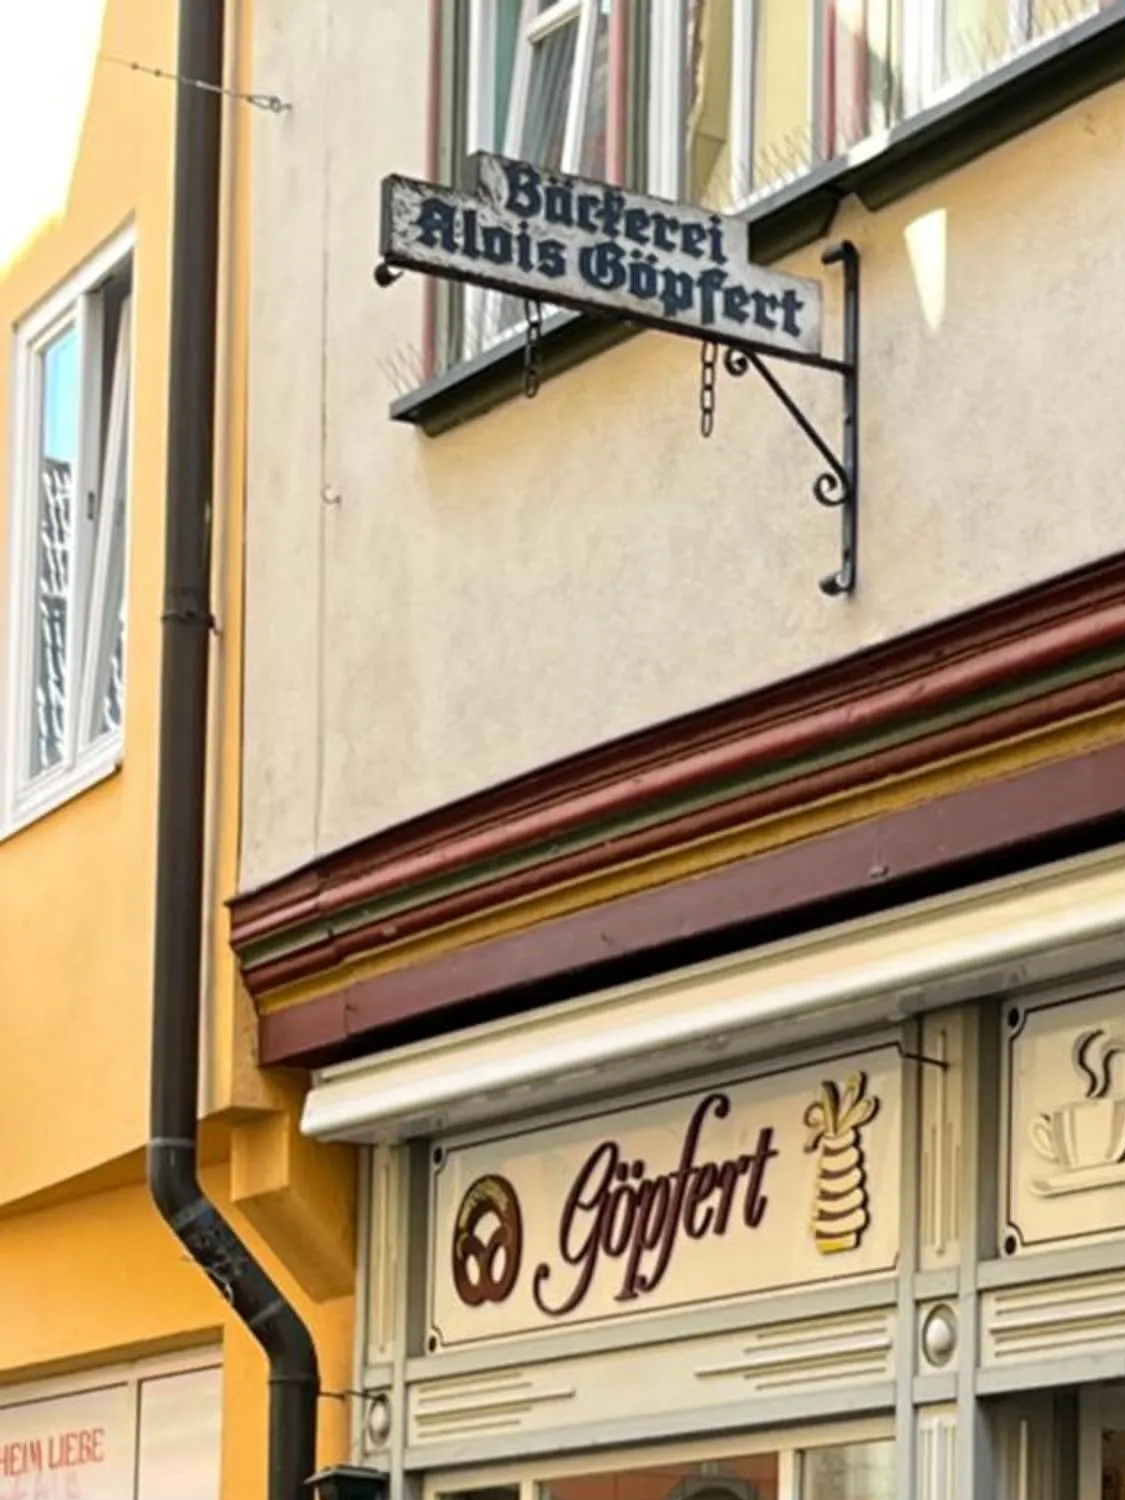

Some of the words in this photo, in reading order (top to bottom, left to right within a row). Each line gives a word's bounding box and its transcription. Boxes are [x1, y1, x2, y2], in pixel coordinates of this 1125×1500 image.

[415, 198, 567, 278] Alois
[578, 242, 805, 338] Göpfert
[503, 162, 728, 265] Bäckerei
[532, 1092, 778, 1317] Göpfert
[48, 1428, 105, 1470] LIEBE
